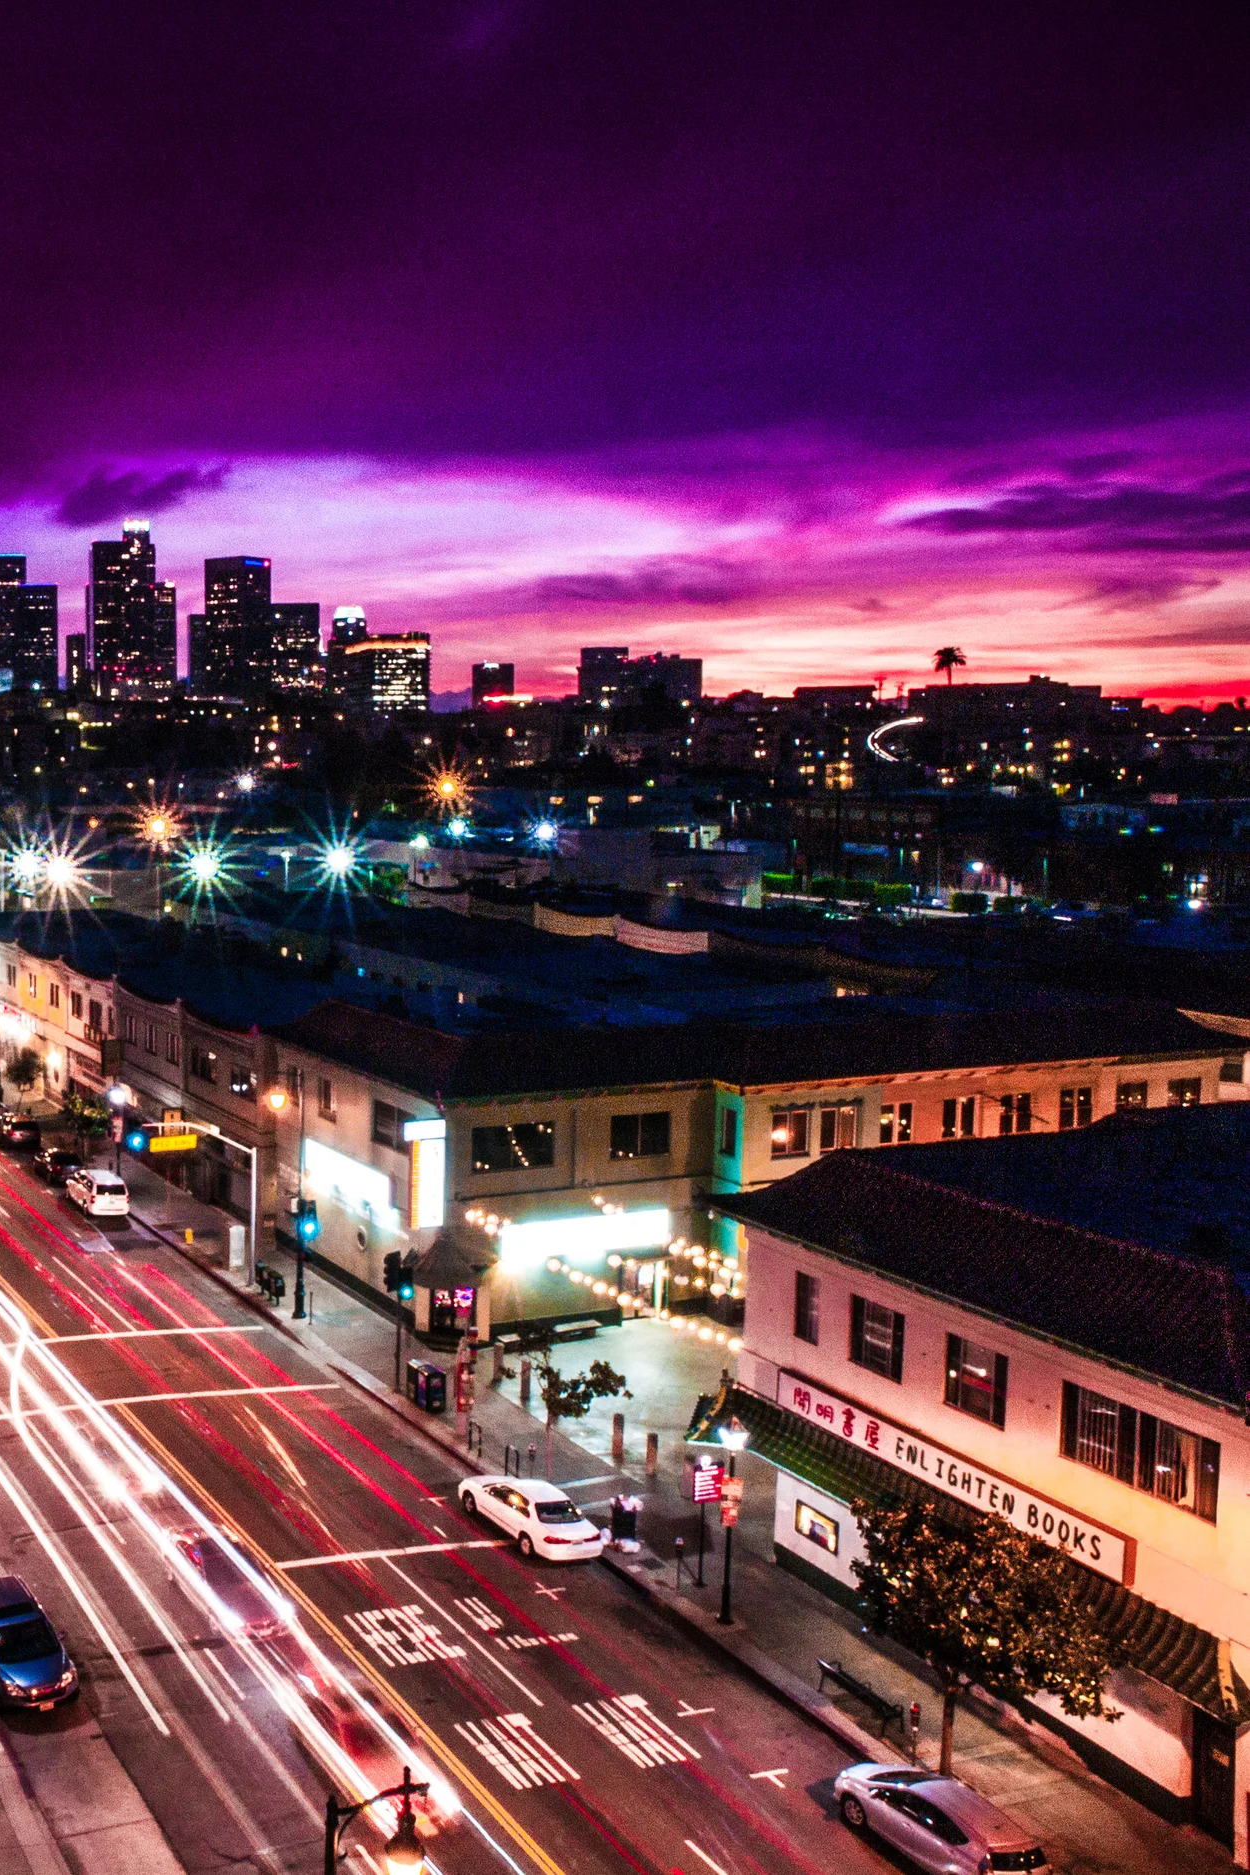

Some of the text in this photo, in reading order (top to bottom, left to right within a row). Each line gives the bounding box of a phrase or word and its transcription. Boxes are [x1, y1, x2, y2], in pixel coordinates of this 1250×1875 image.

[895, 1436, 1102, 1562] ENLIGHTEN BOOKS
[343, 1604, 467, 1668] HERE
[453, 1712, 582, 1790] WAIT
[571, 1693, 702, 1769] WAIT
